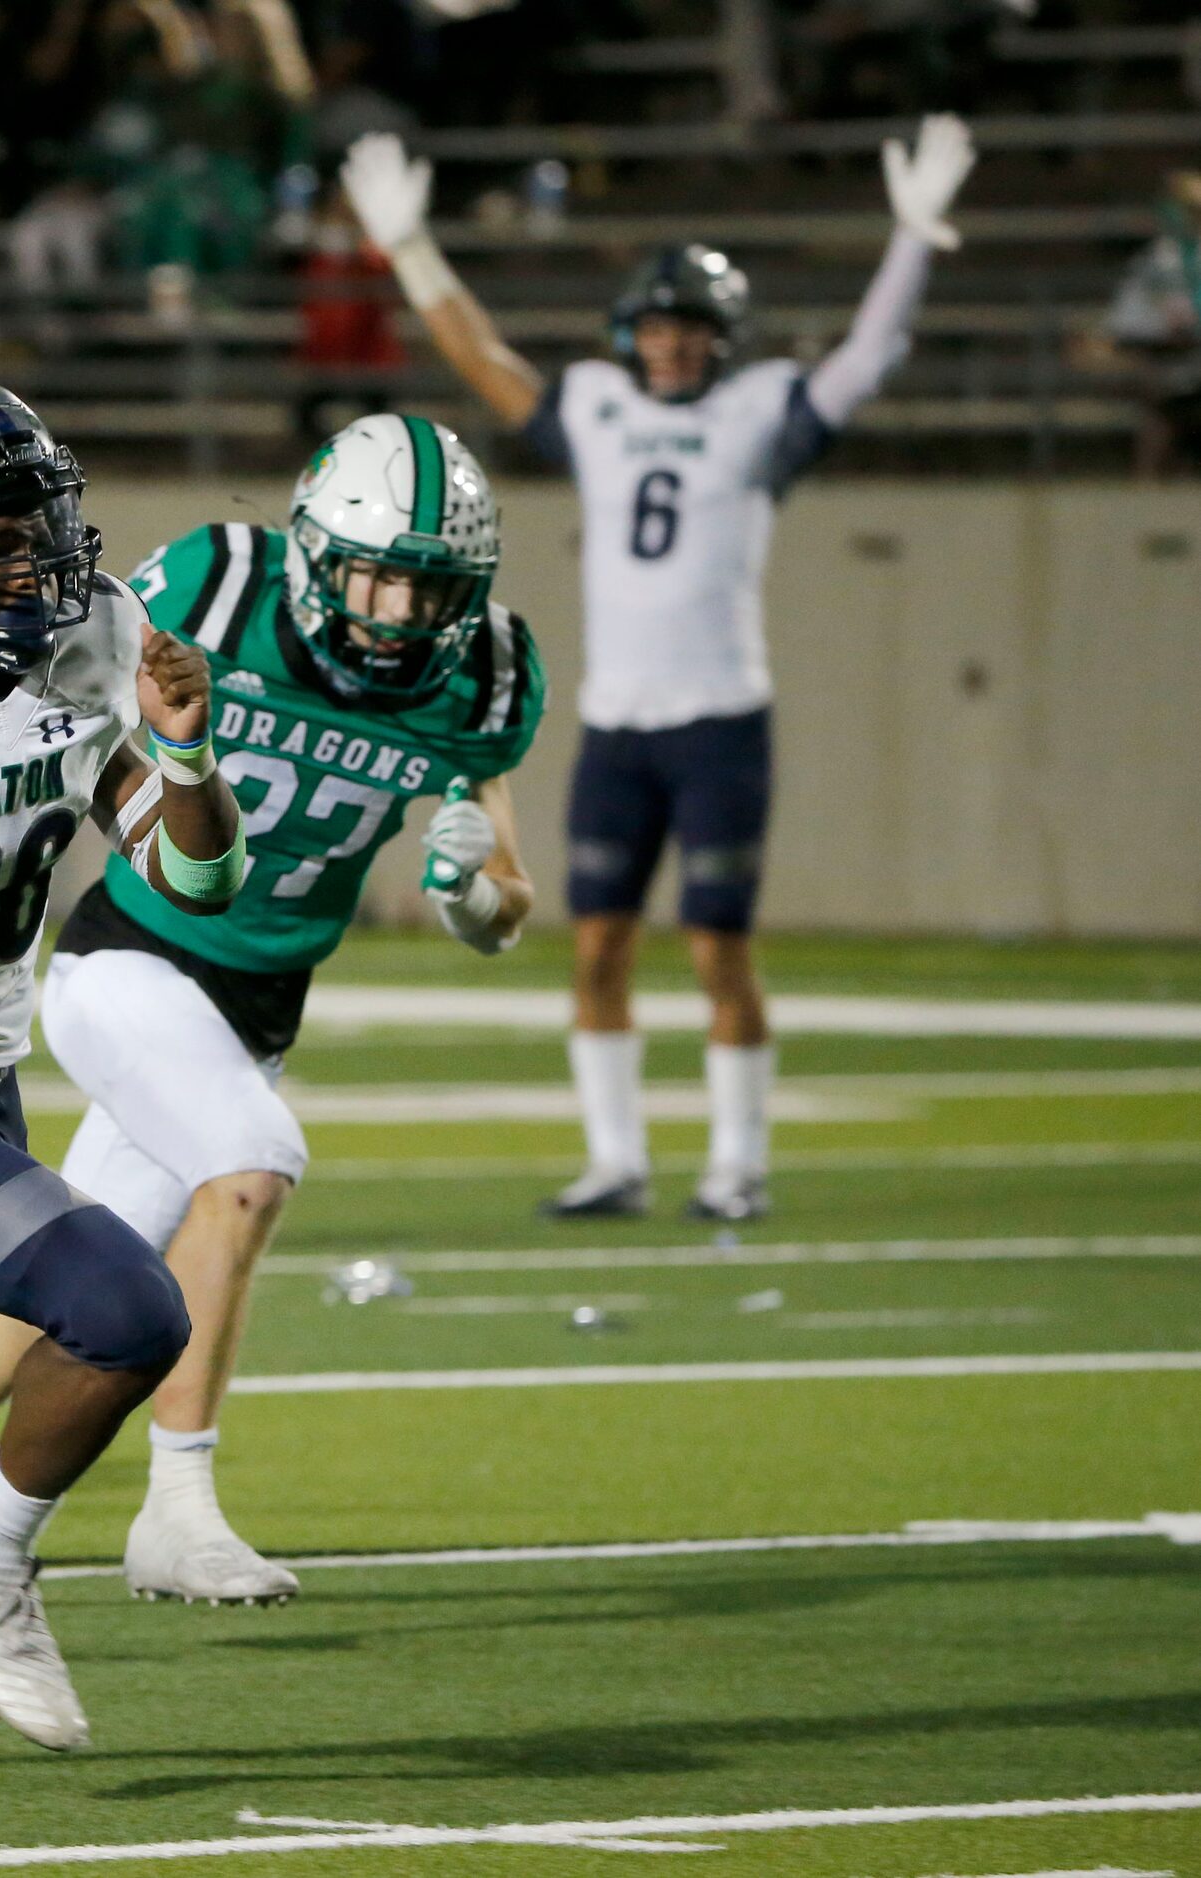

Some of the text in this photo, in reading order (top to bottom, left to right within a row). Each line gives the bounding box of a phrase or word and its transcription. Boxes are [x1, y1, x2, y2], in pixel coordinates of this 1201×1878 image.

[630, 469, 682, 561] 6
[215, 702, 430, 791] DRAGONS
[216, 750, 396, 898] 27
